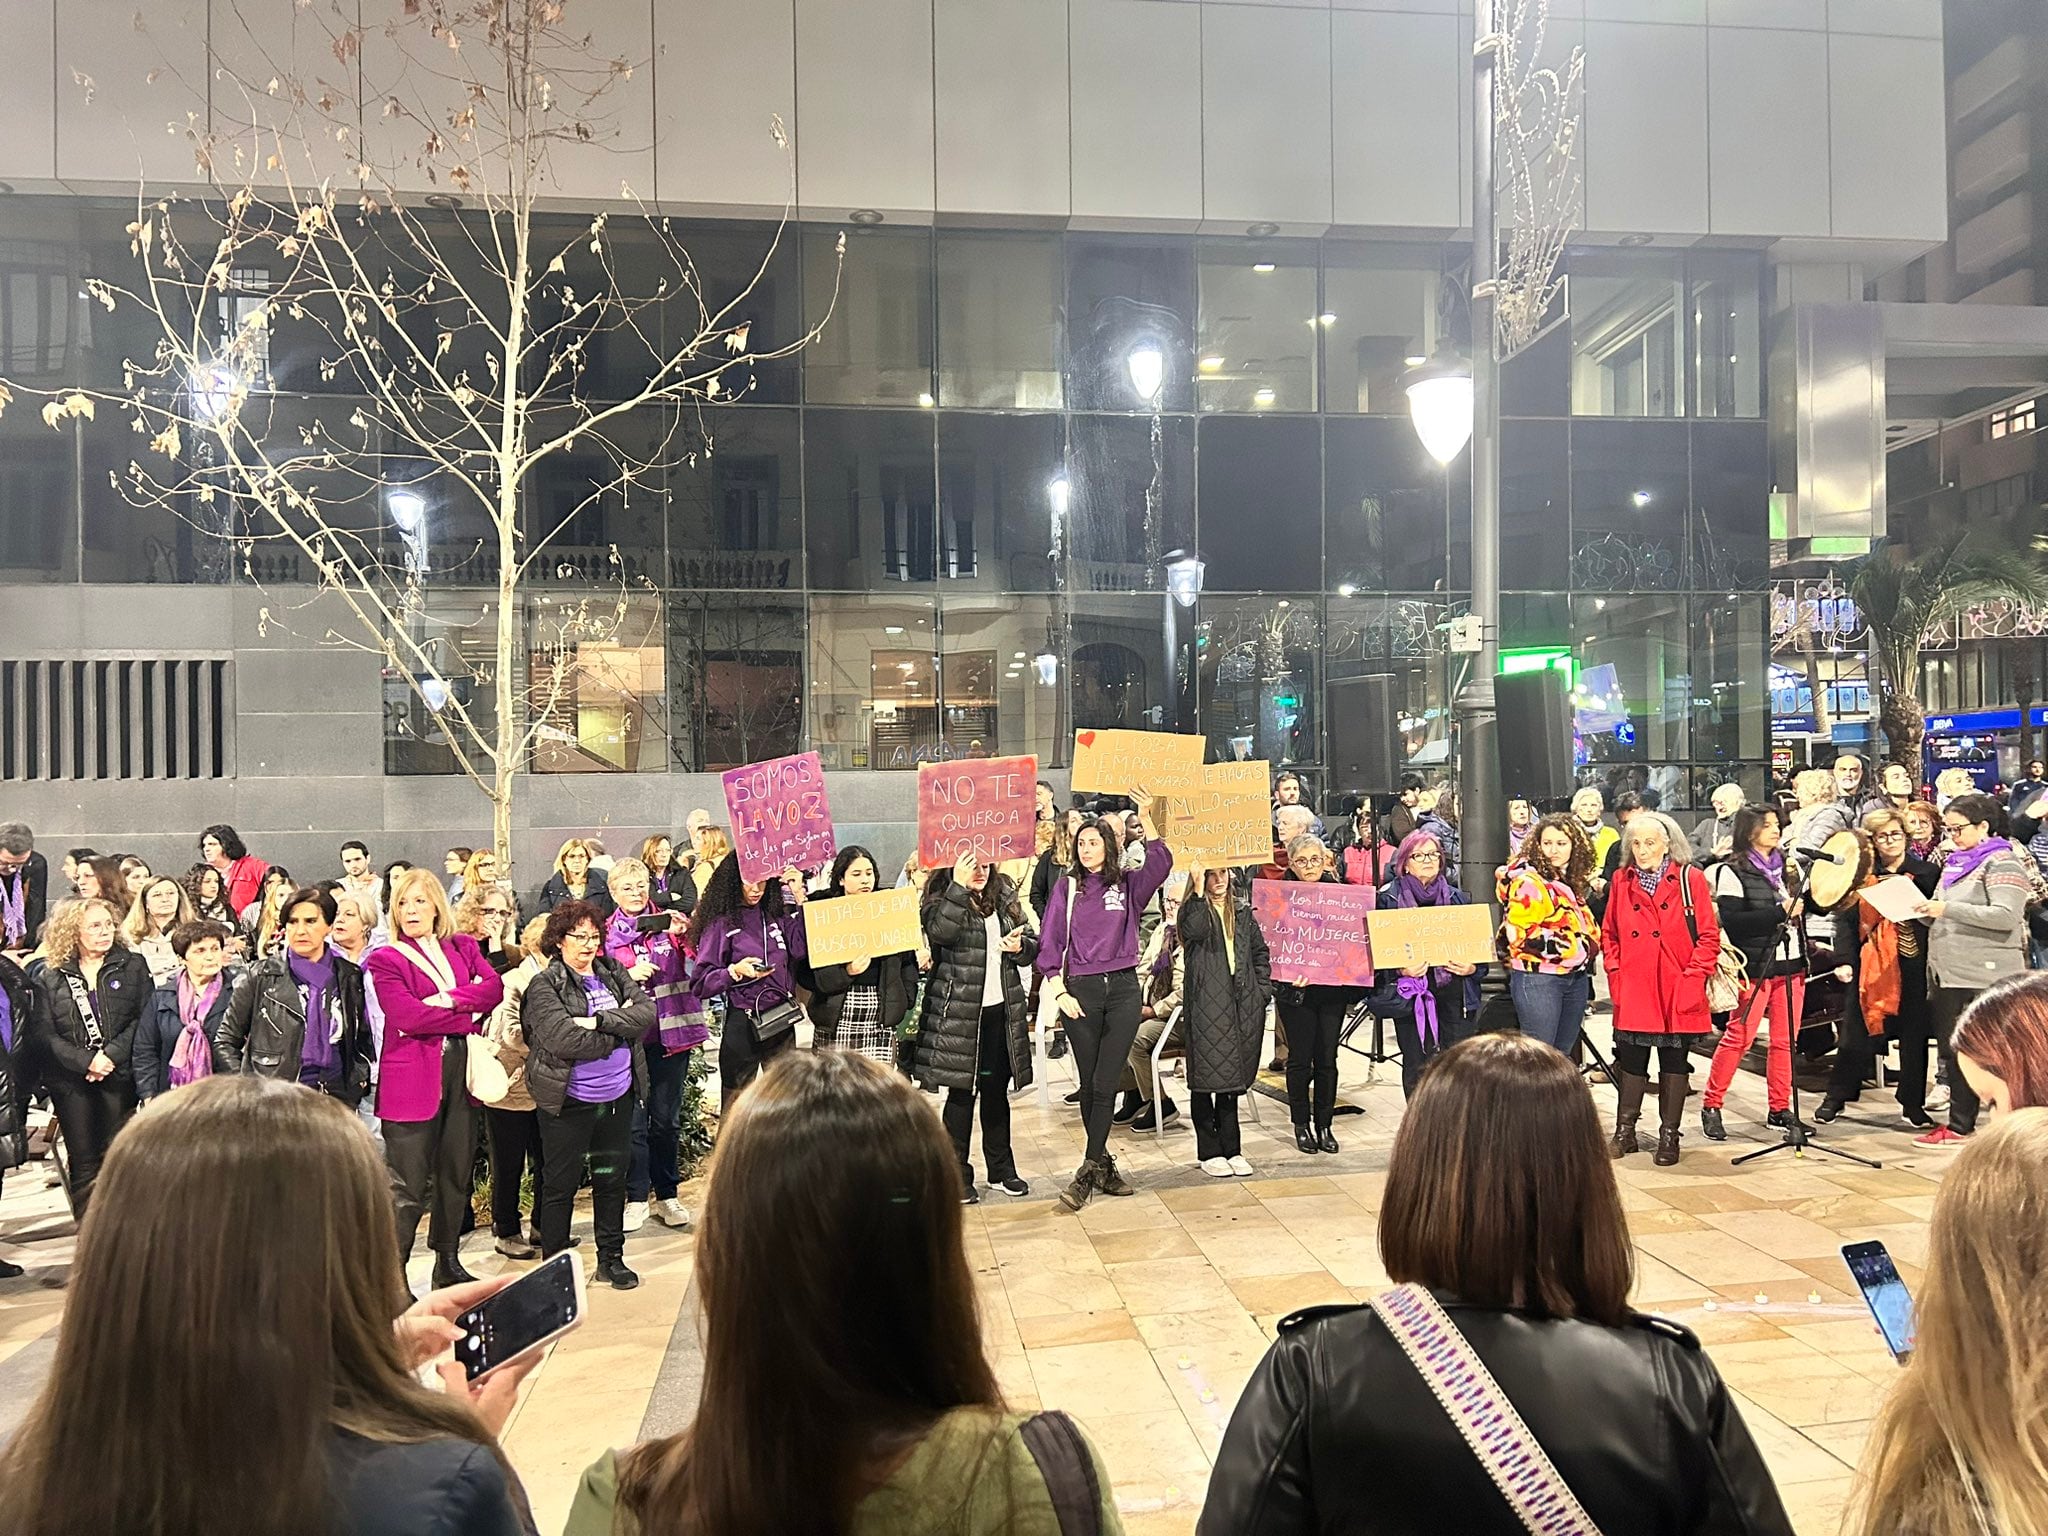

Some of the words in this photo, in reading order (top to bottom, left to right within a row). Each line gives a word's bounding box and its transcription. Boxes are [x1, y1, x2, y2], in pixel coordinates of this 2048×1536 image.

[1933, 718, 1953, 730] BBVA
[734, 760, 812, 803] SOMOS
[1218, 764, 1264, 785] HAGAS
[932, 775, 975, 806] NO
[987, 773, 1022, 802] TE
[738, 808, 766, 836] LA
[766, 791, 824, 832] VOZ
[1200, 792, 1221, 812] LO
[942, 809, 1005, 832] QUIERO
[1009, 809, 1019, 825] A
[1228, 818, 1254, 831] QUE
[745, 843, 760, 860] de
[762, 836, 778, 856] las
[934, 833, 1016, 859] MORIR
[1225, 832, 1271, 856] MADRE
[1316, 891, 1363, 910] hombres
[814, 901, 865, 928] HIJAS
[867, 900, 888, 920] DE
[1291, 908, 1323, 920] tienen
[1326, 912, 1358, 922] miedo
[1272, 921, 1295, 935] las
[812, 932, 867, 953] BUSCAD
[871, 928, 901, 949] UNA
[1264, 939, 1277, 947] ue
[1281, 940, 1305, 954] NO
